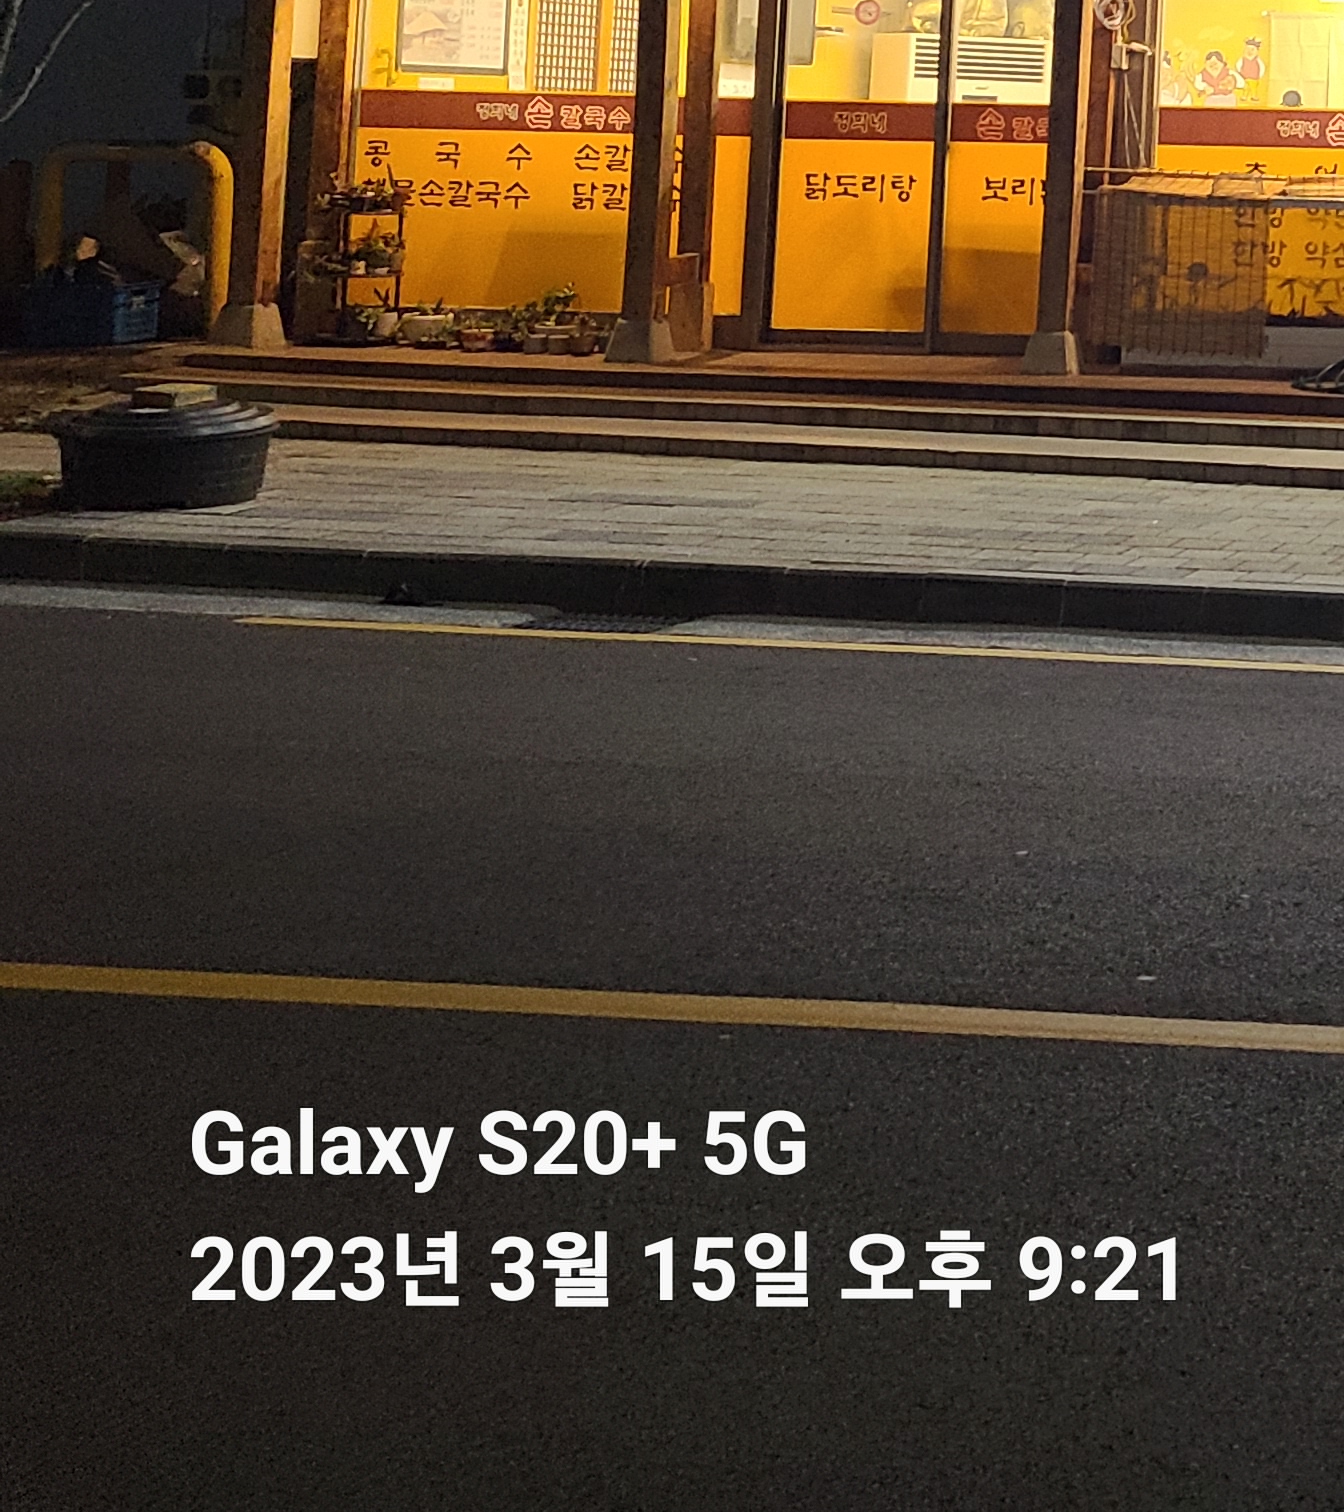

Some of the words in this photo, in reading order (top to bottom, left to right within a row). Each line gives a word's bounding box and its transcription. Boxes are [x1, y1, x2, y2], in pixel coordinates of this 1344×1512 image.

[476, 103, 519, 121] 정희네
[834, 111, 887, 134] 정희네
[1277, 120, 1320, 139] 정희네
[804, 173, 917, 202] 닭도리탕
[981, 176, 1046, 205] 보리
